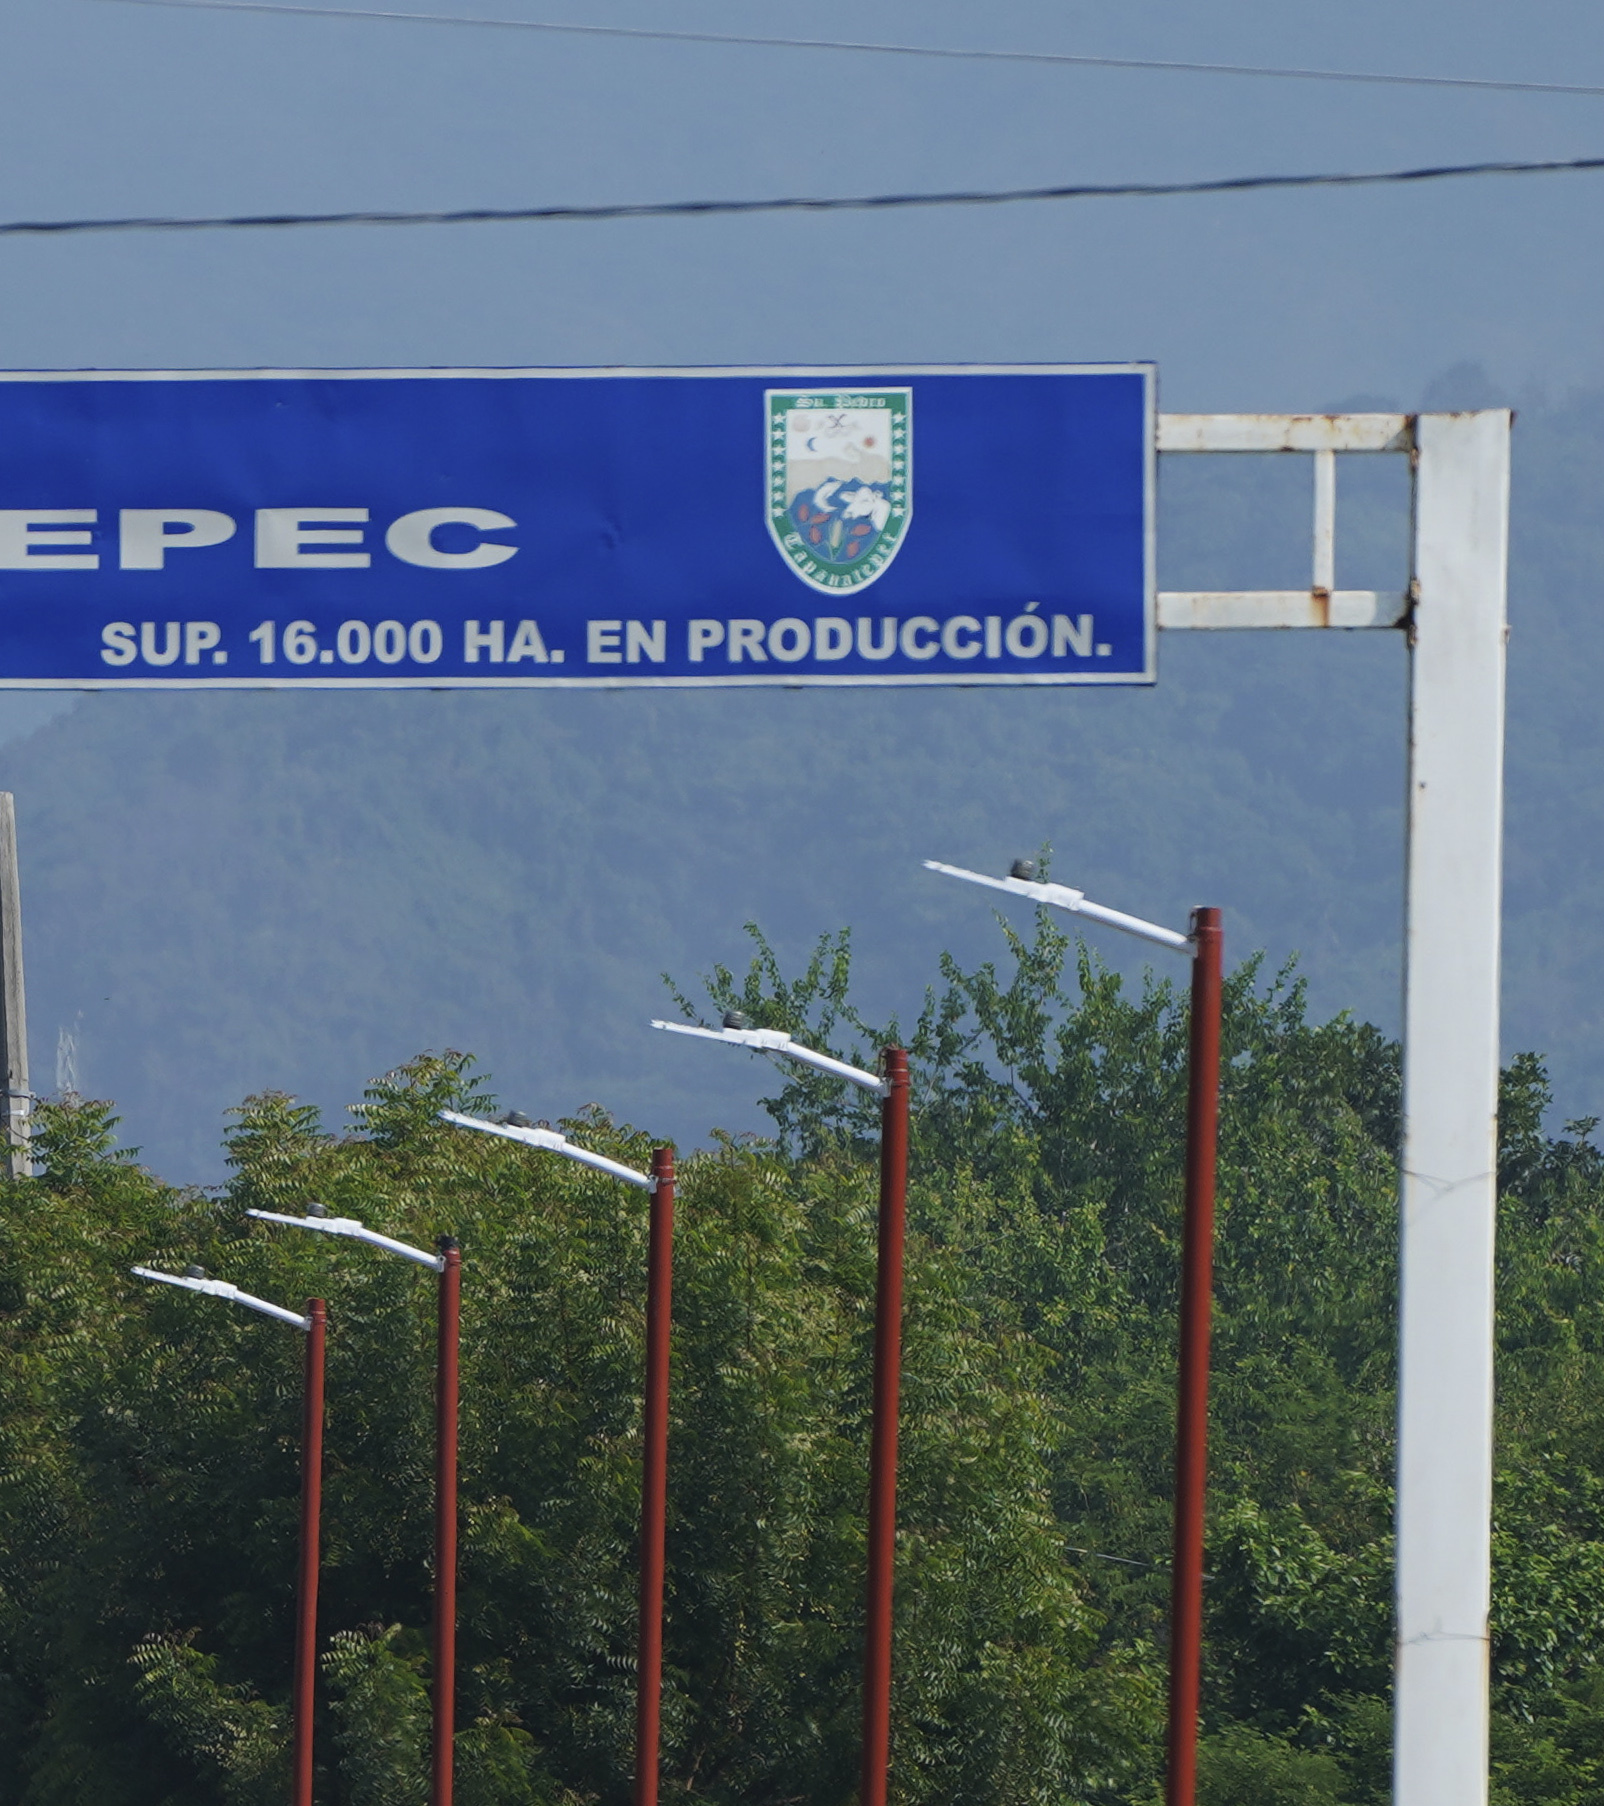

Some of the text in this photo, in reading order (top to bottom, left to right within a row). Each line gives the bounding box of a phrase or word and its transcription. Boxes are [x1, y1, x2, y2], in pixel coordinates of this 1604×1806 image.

[100, 604, 1111, 666] SUP. 16.000 HA. EN PRODUCCIÓN.
